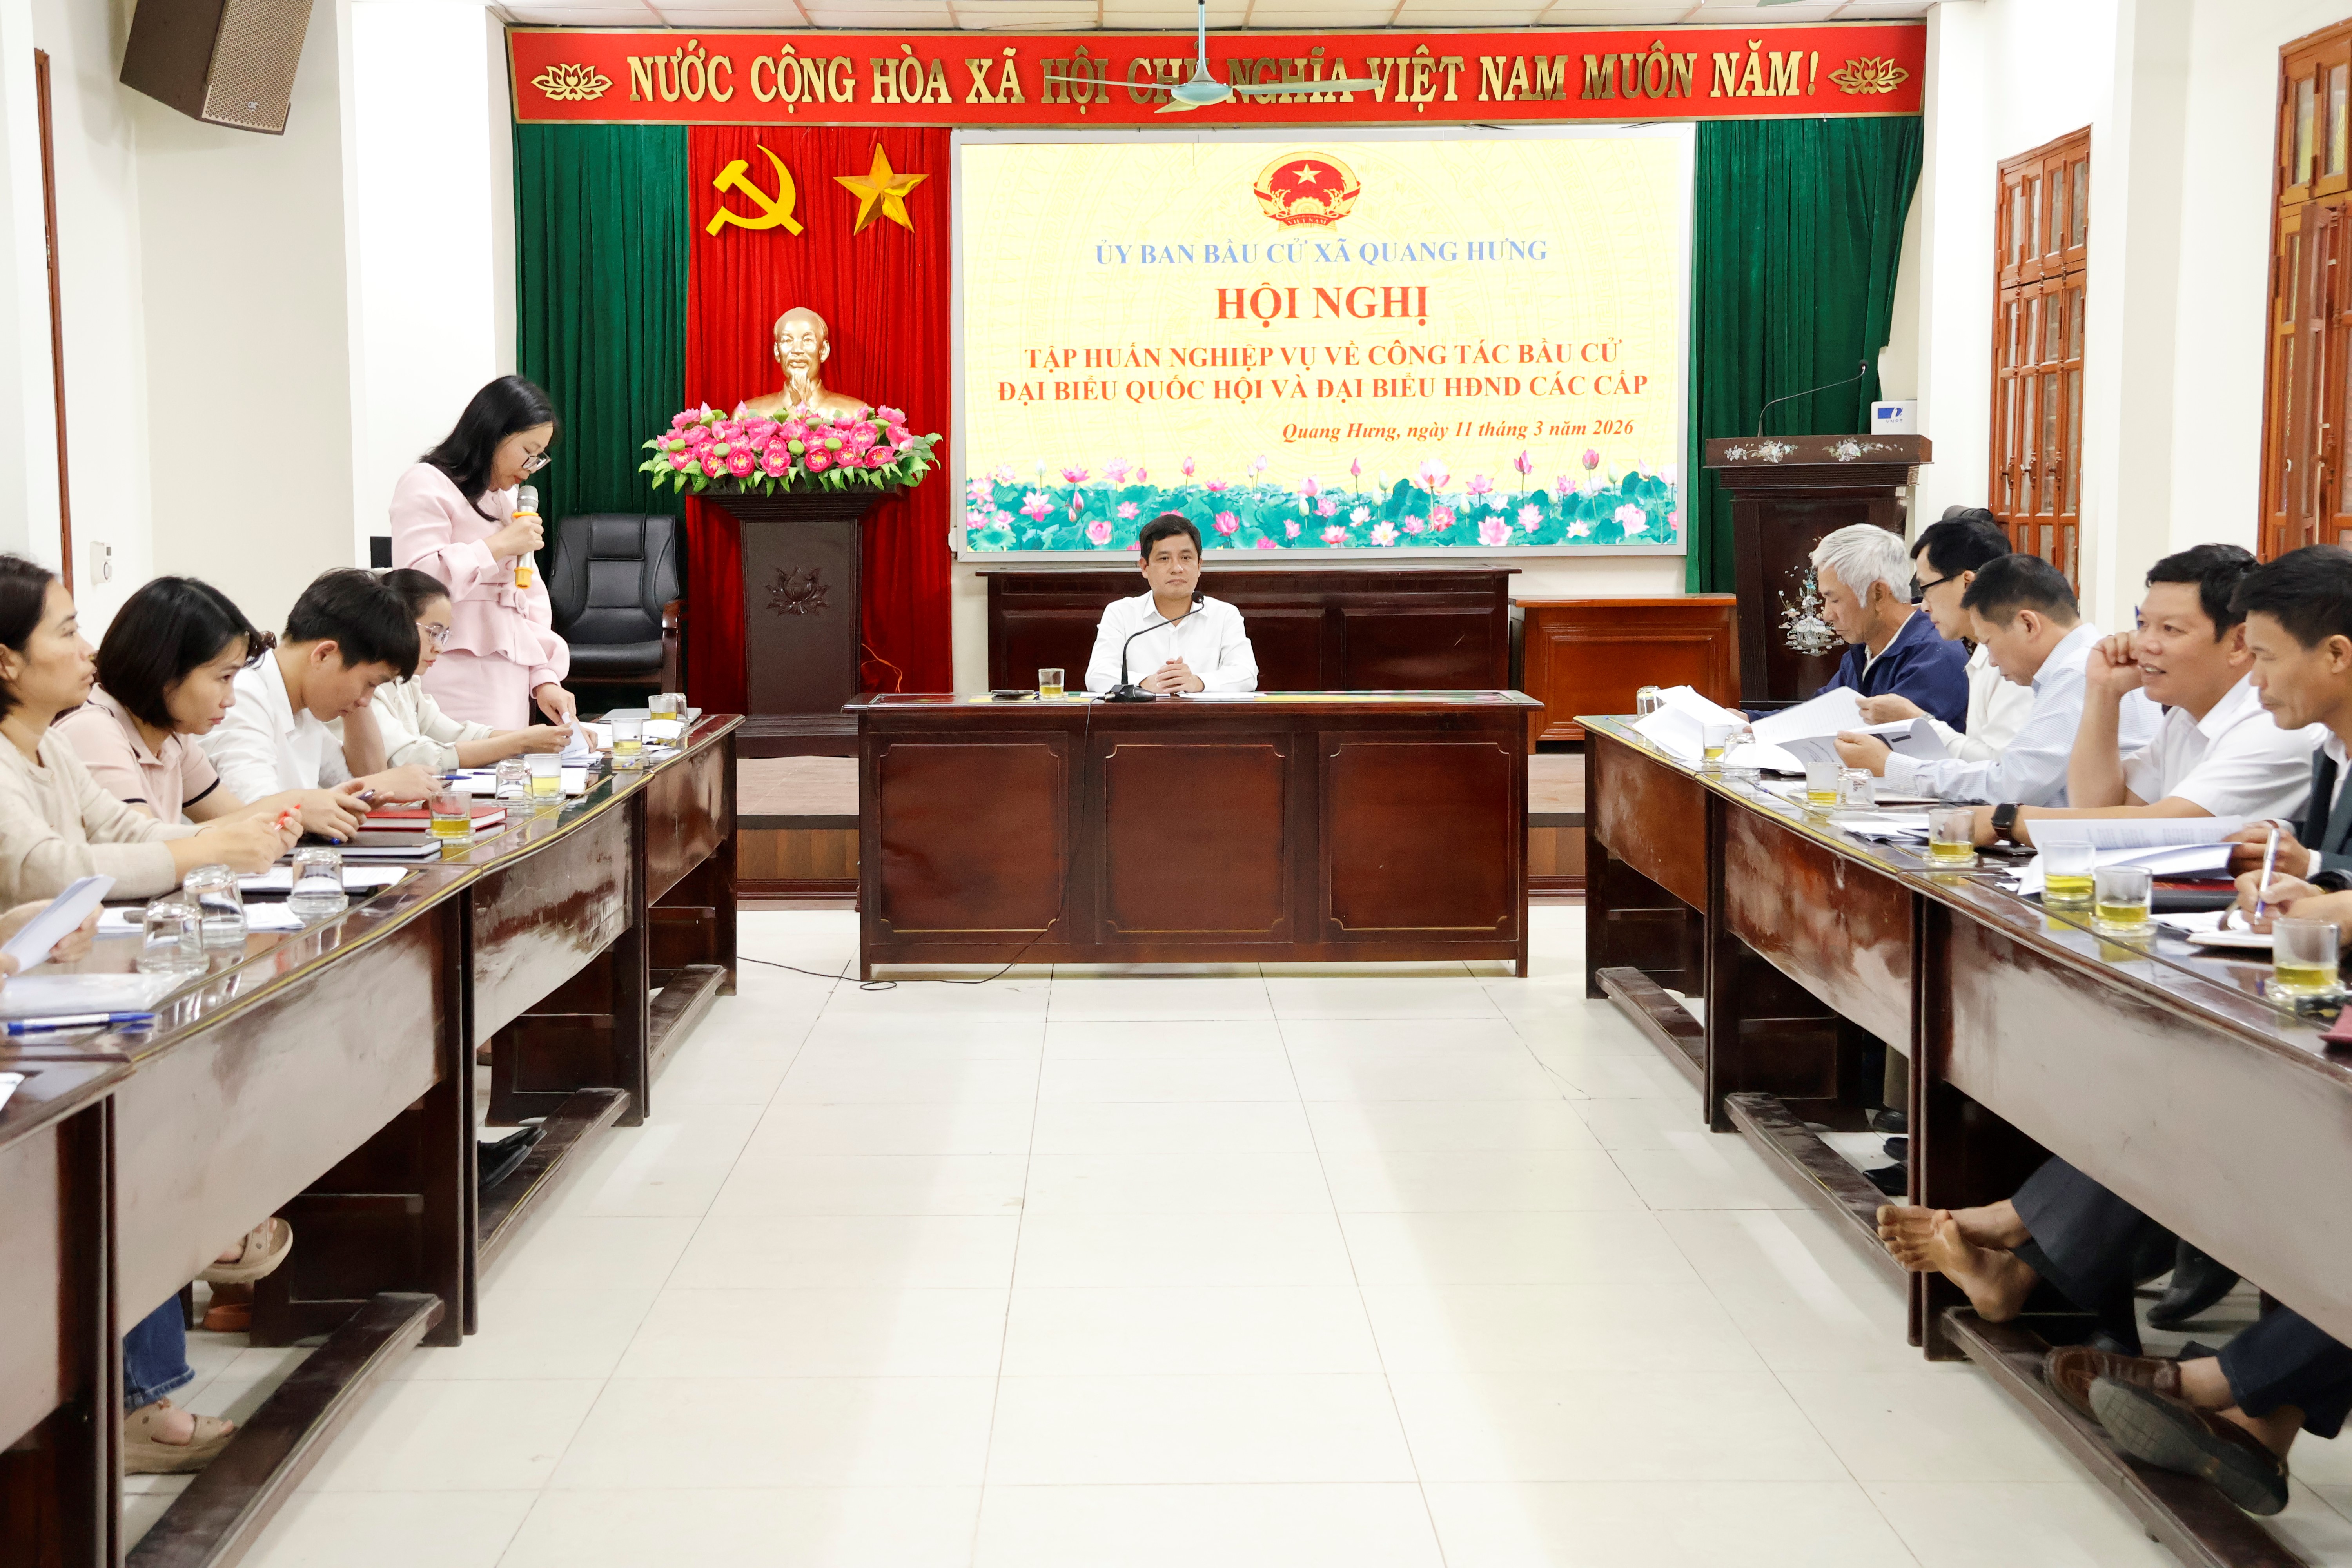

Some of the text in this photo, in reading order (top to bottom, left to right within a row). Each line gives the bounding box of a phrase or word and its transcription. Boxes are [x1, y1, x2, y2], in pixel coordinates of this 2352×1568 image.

[627, 39, 733, 102] NƯỚC
[751, 42, 855, 114] CỘNG
[870, 44, 952, 103] HÒA
[965, 47, 1025, 103] XÃ
[1040, 45, 1110, 115] HỘI
[1226, 46, 1354, 104] NGHĨA
[1366, 44, 1465, 113] VIỆT
[1478, 55, 1568, 101] NAM
[1582, 39, 1697, 100] MUÔN
[1096, 238, 1548, 266] ỦY BAN BẦU CỬ XÃ QUANG HƯNG
[1216, 282, 1429, 328] HỘI NGHỊ
[1025, 337, 1622, 373] TẬP HUẤN NGHIỆP VỤ VỀ CÔNG TÁC BẦU CỬ
[998, 370, 1648, 406] ĐẠI BIỂU QUỐC HỘI VÀ ĐẠI BIỂU HĐND CÁC CẤP
[1282, 420, 1635, 443] Quang Hưng, ngày 11 tháng 3 năm 2026
